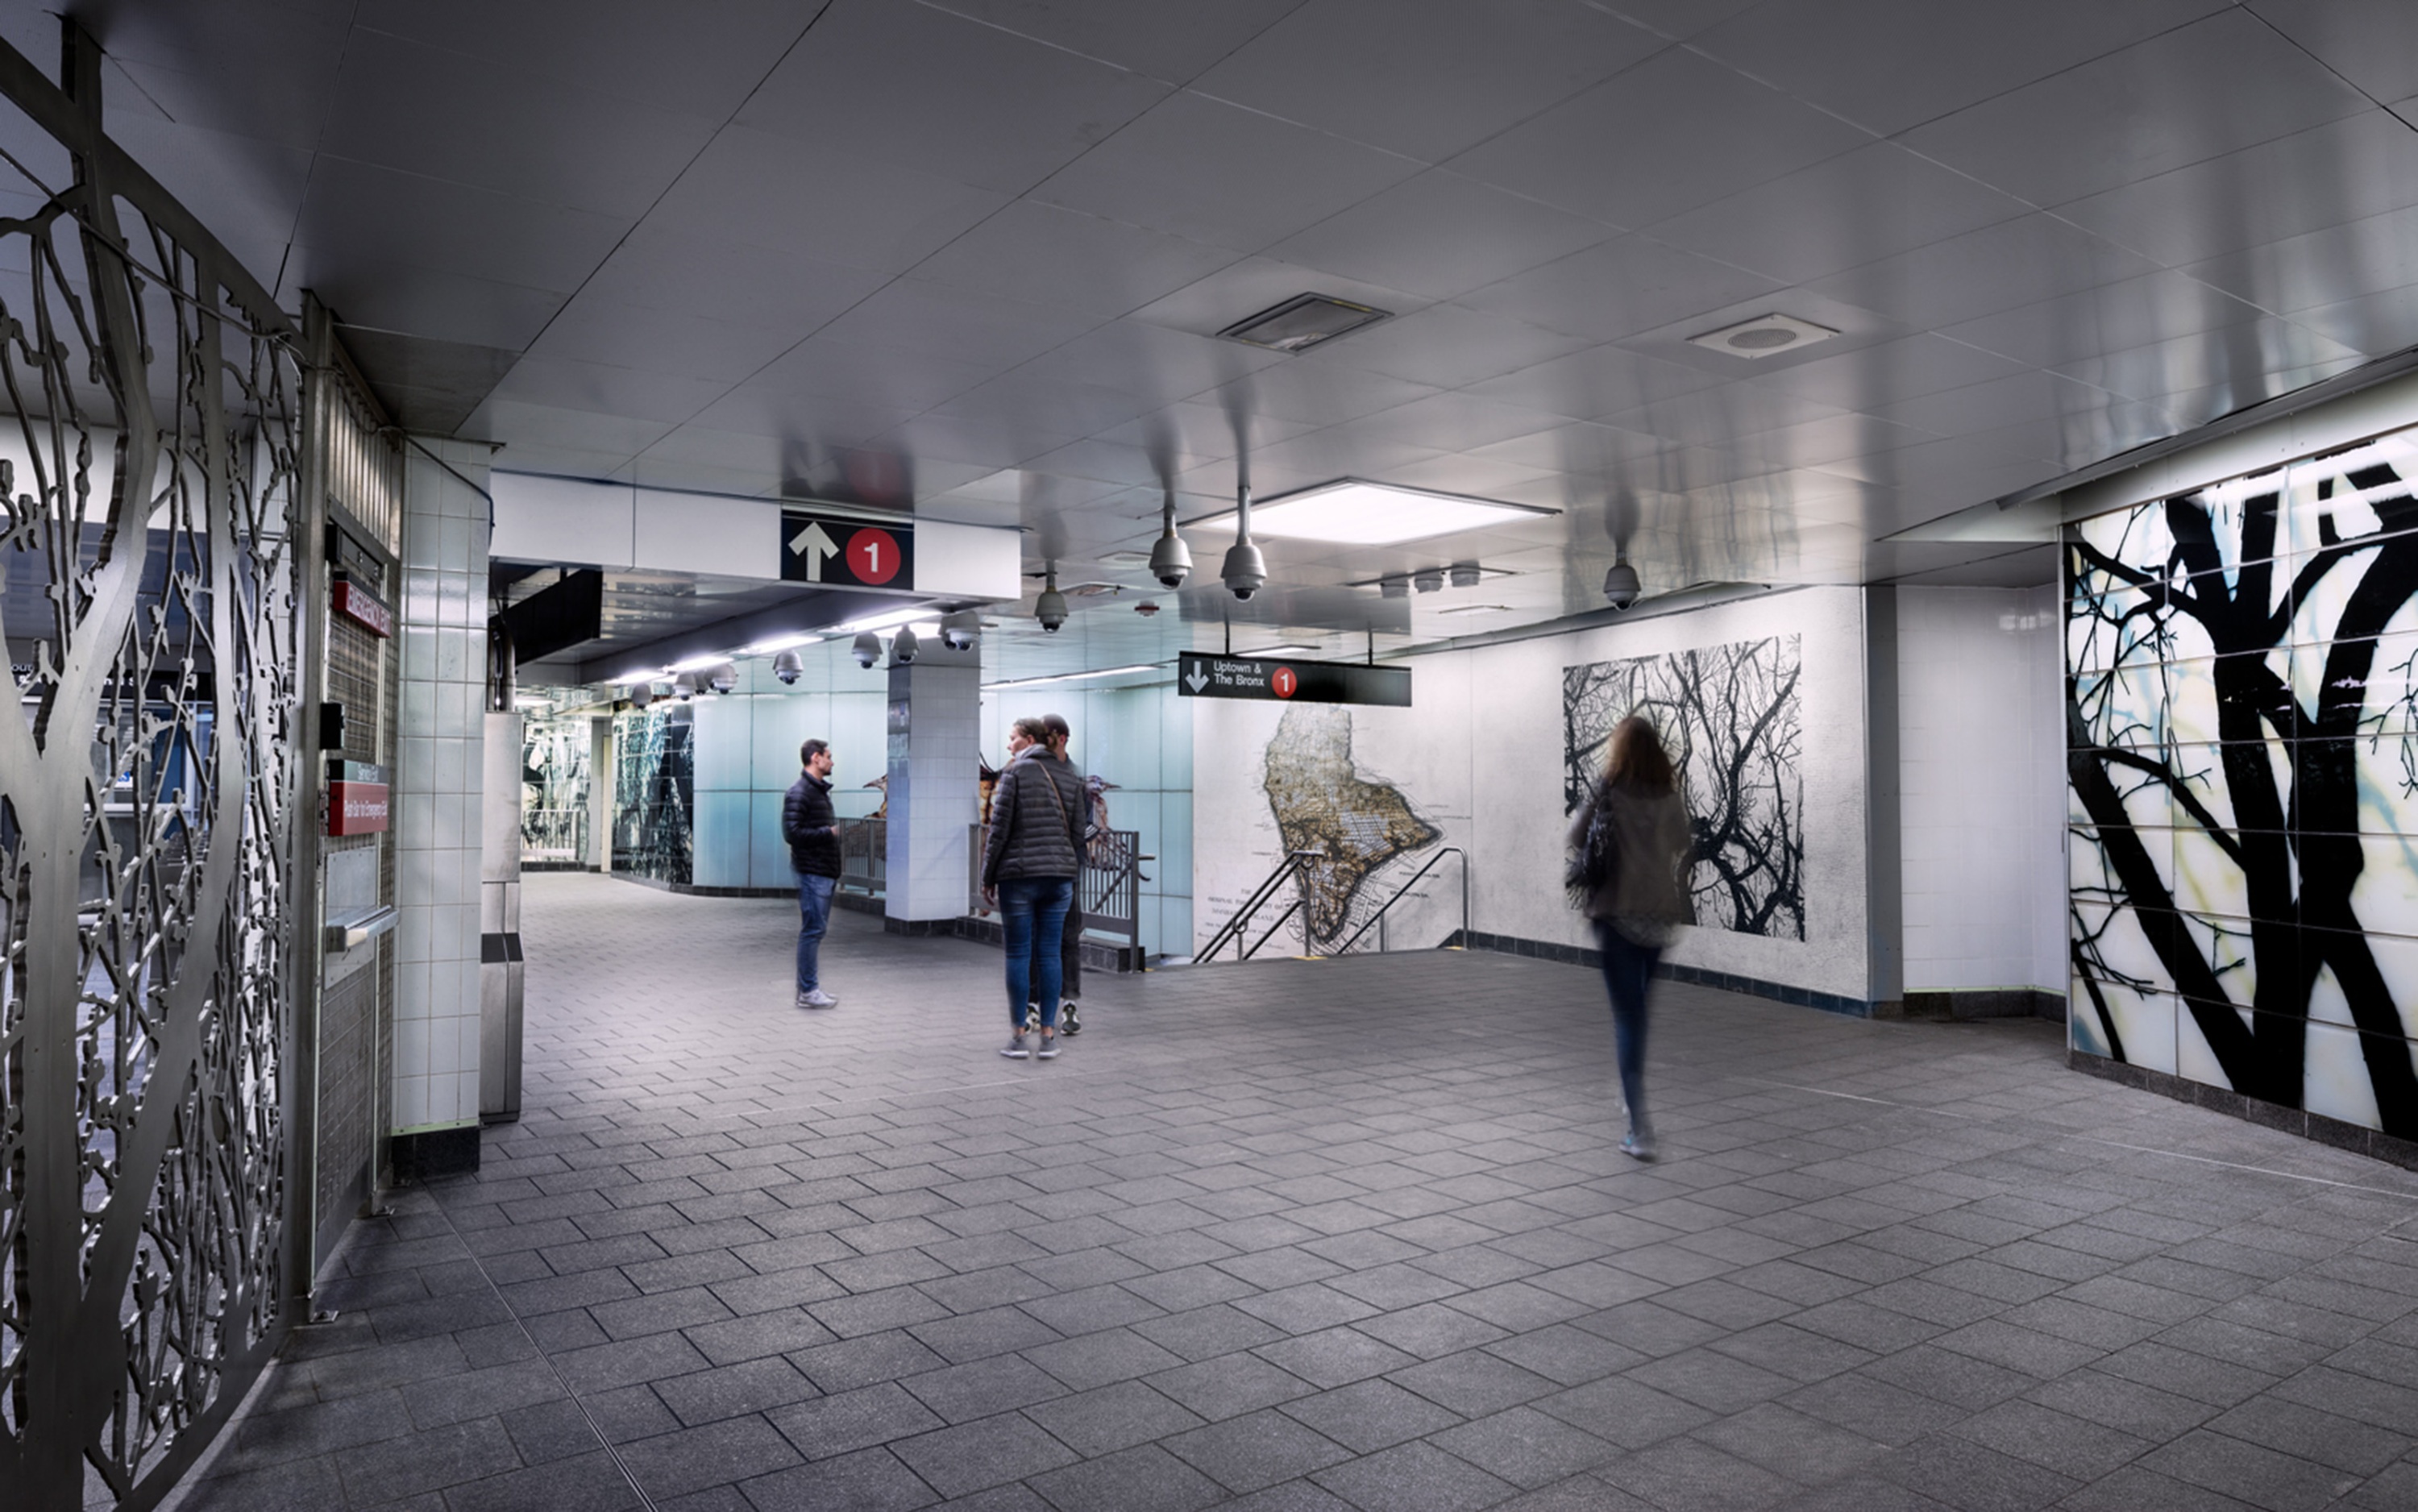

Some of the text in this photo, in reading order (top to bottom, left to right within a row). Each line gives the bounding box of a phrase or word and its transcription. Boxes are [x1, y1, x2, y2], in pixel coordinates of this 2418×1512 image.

[864, 542, 879, 573] 1
[1214, 660, 1262, 674] Uptown &
[1214, 673, 1265, 686] The Bronx
[1280, 673, 1289, 692] 1
